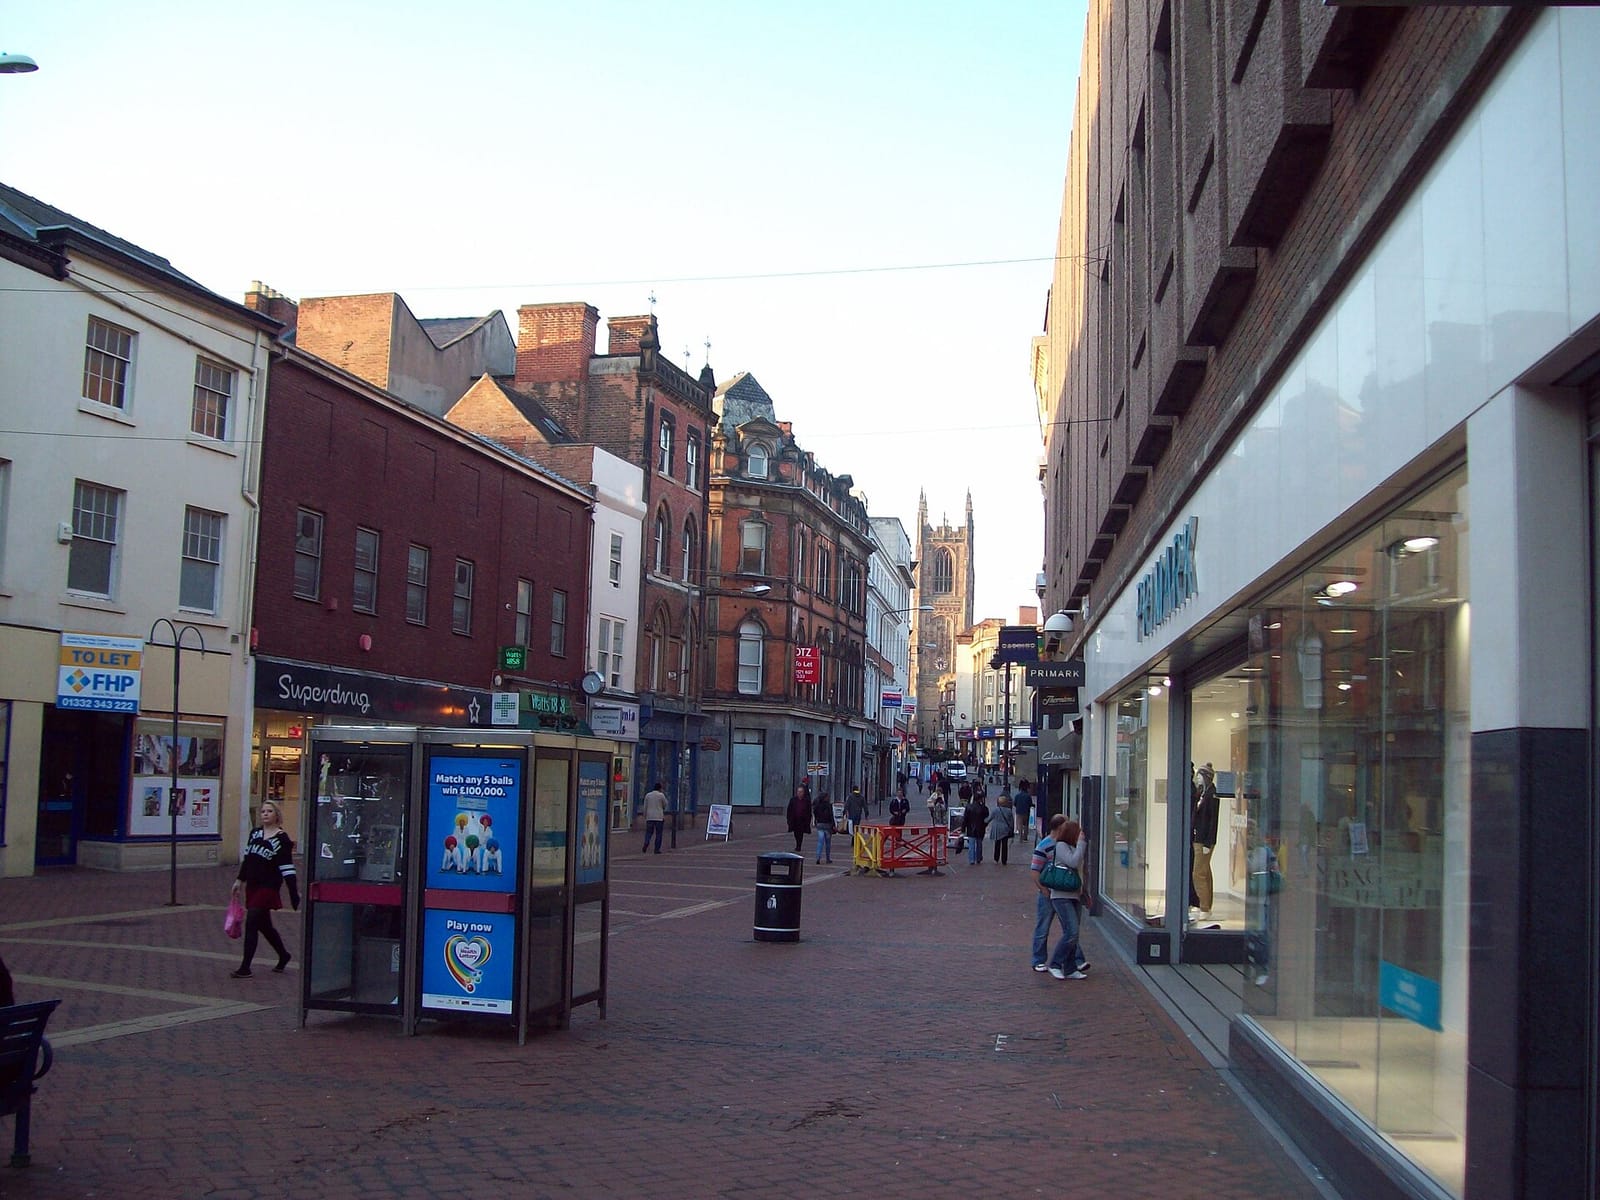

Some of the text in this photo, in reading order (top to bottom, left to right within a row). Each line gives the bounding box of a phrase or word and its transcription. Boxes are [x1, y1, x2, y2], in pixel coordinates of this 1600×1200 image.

[72, 650, 132, 666] TO LET
[1030, 669, 1080, 678] PRIMARK
[92, 673, 135, 692] FHP
[278, 674, 371, 714] Superdrug
[62, 697, 134, 710] 01332 343 222
[551, 697, 566, 714] 188
[436, 774, 513, 786] Match any 5 balls
[442, 785, 506, 797] win £100,000.
[447, 920, 492, 932] Play now
